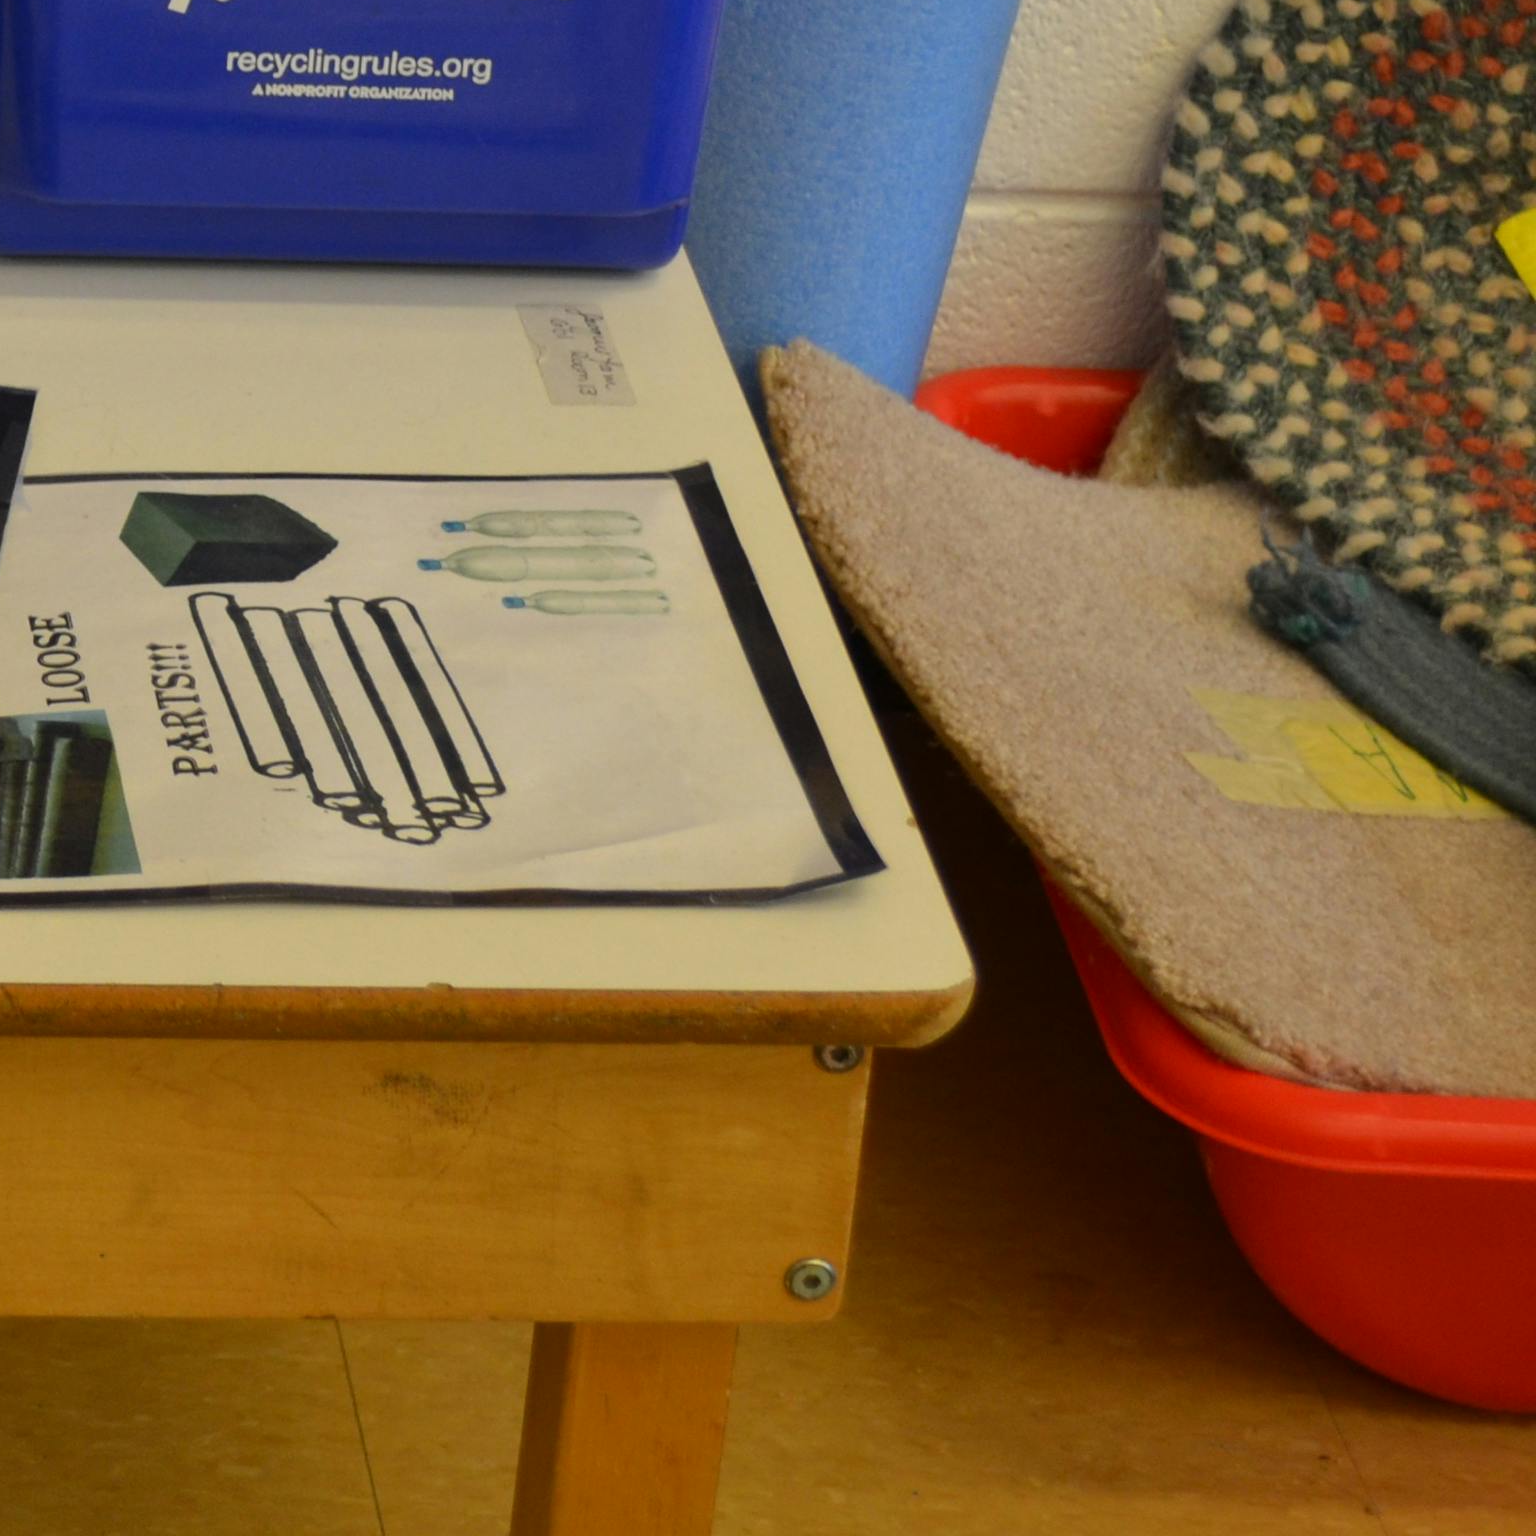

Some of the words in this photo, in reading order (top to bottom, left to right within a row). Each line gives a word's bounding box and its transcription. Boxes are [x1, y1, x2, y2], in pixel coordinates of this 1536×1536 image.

[226, 48, 493, 85] recyclingrules.org
[252, 83, 265, 96] A
[265, 84, 347, 99] NONPROFIT
[349, 86, 454, 101] ORGANIZATION
[28, 611, 91, 706] LOOSE
[145, 641, 219, 777] PARTS!!!
